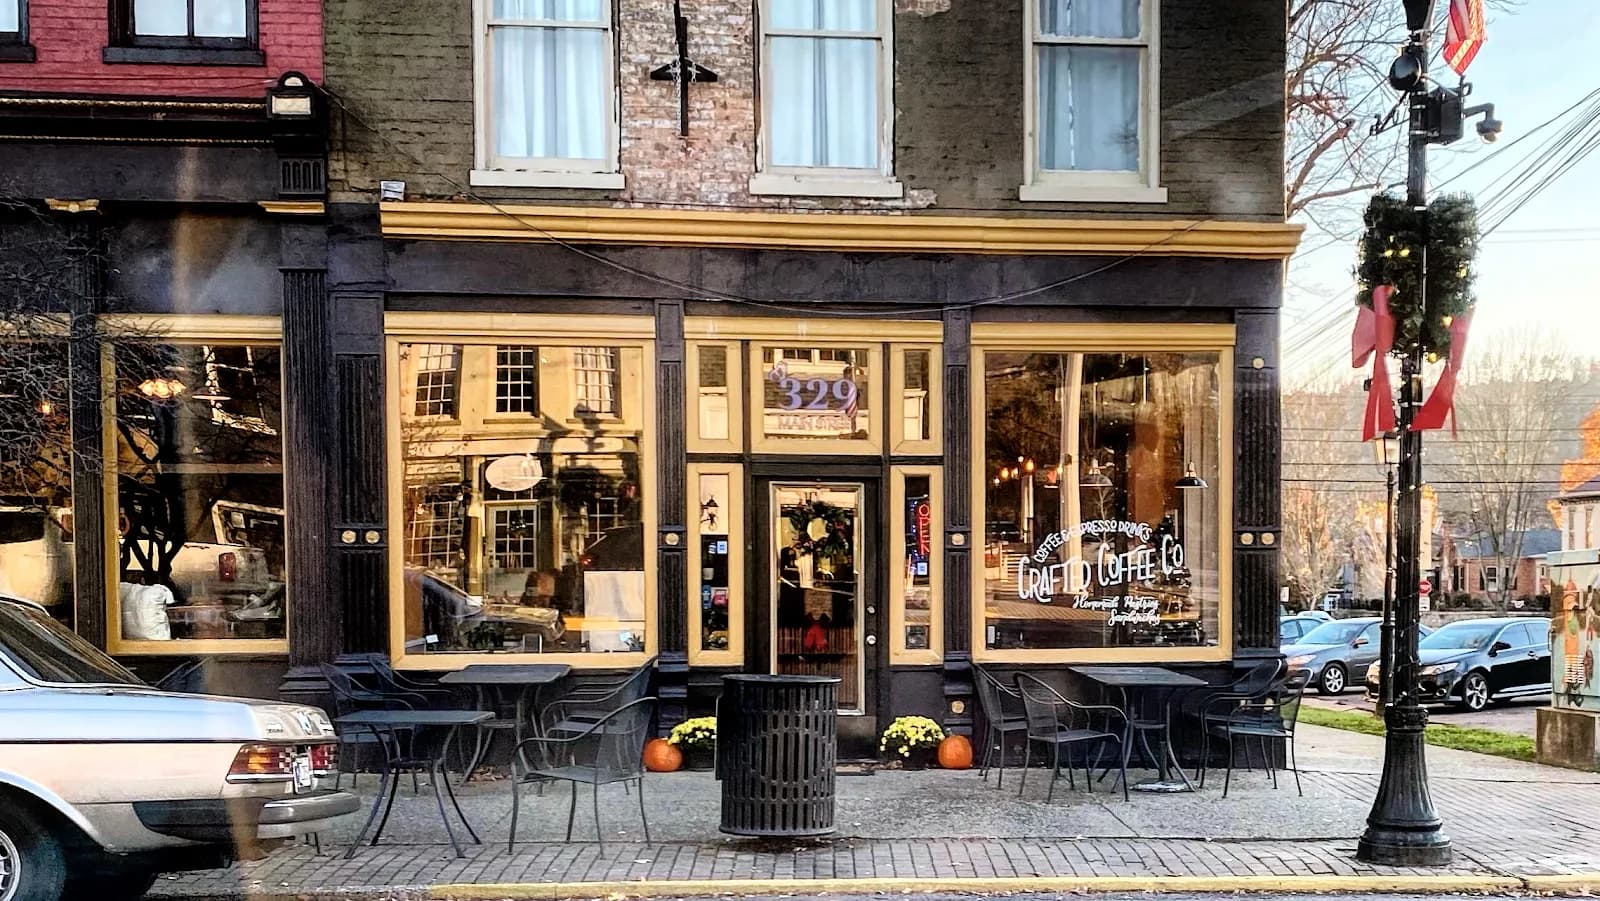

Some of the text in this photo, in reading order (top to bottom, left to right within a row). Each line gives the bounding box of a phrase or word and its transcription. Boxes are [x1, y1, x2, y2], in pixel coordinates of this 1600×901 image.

[779, 377, 858, 411] 329
[918, 503, 932, 556] OPEN
[1033, 532, 1063, 563] COFFEE
[1070, 517, 1117, 537] PRESSO
[1118, 520, 1152, 543] DRINKS
[1097, 542, 1156, 588] COFFEE
